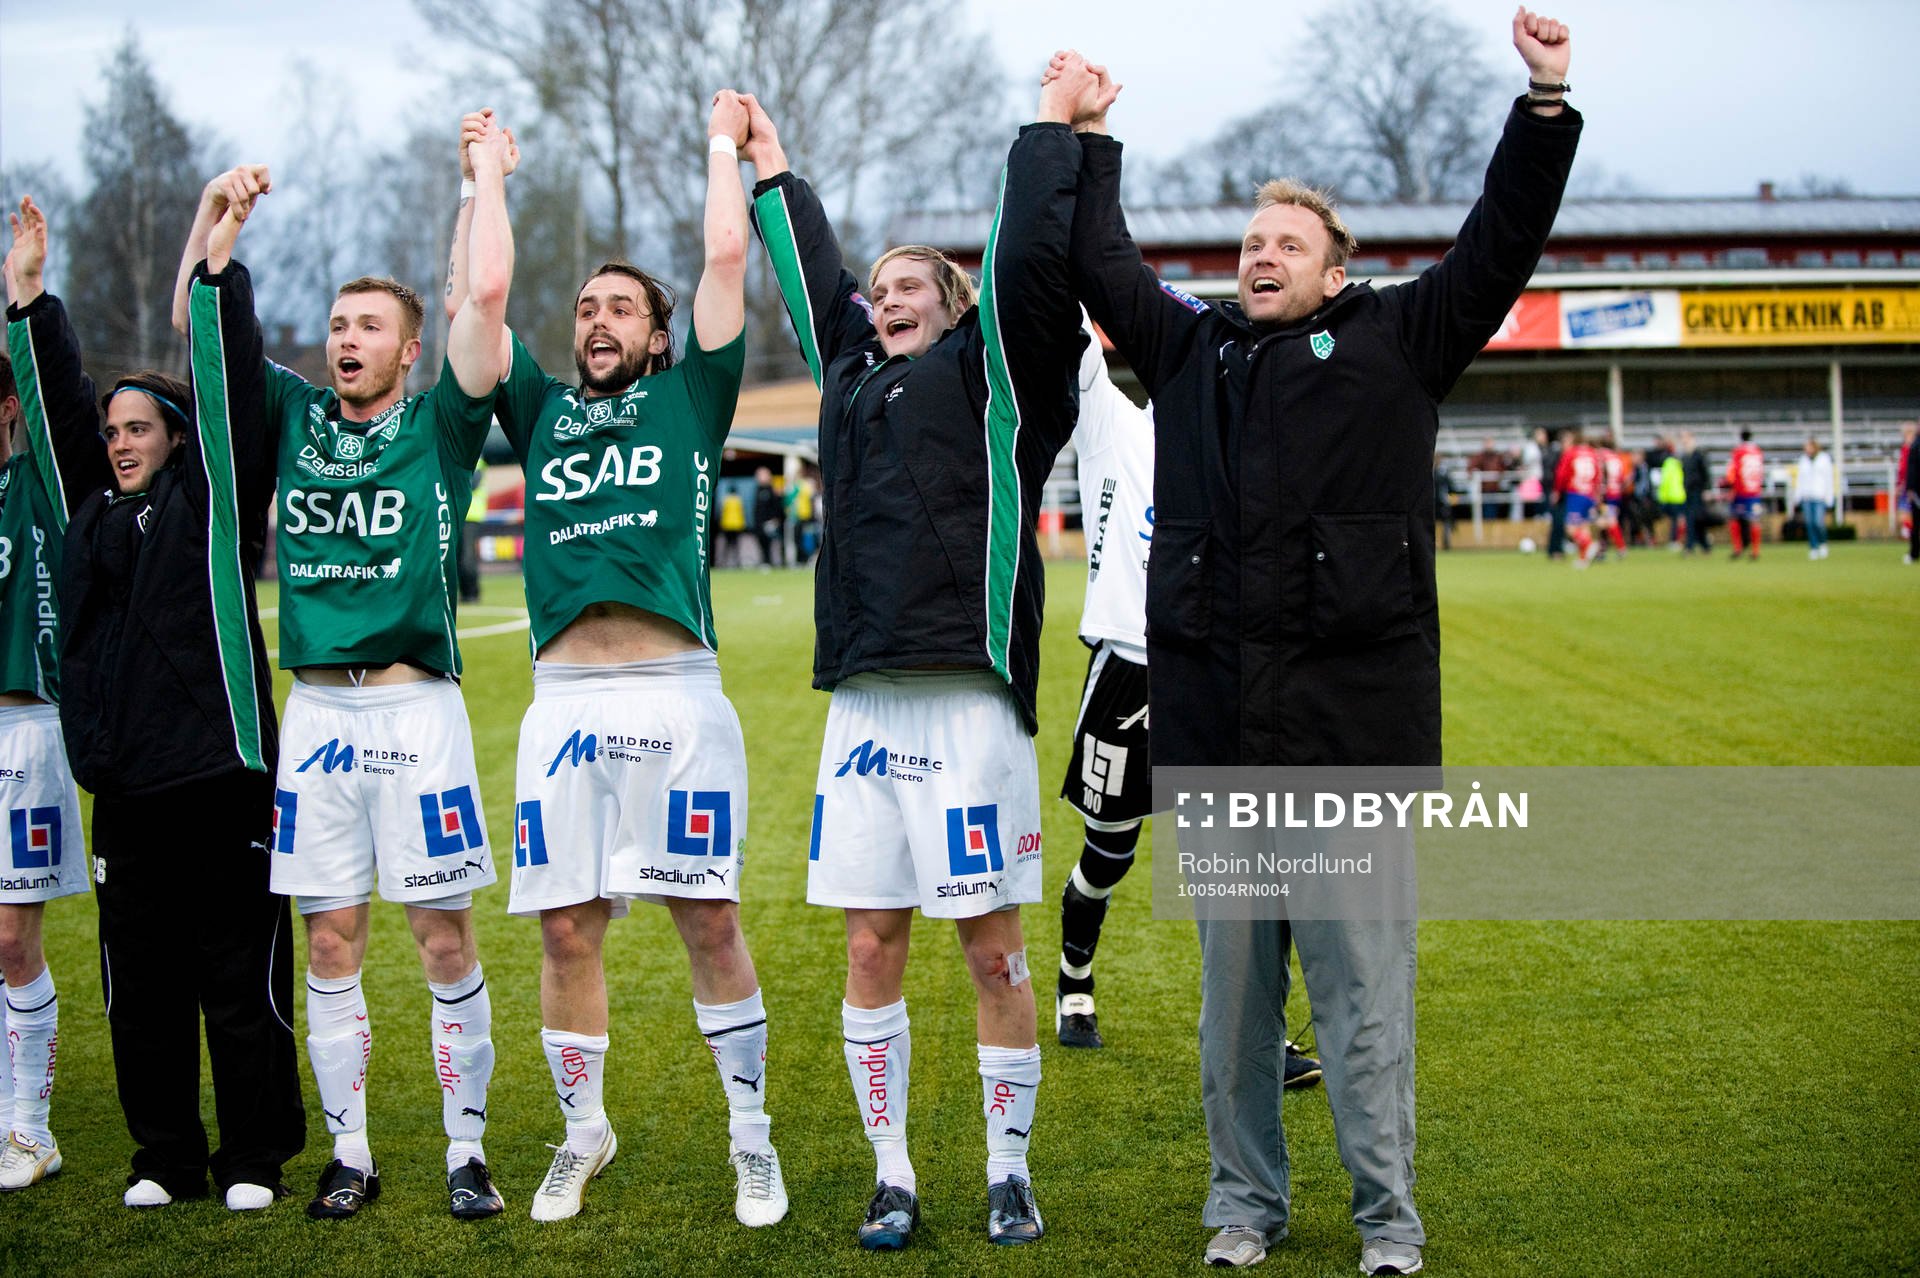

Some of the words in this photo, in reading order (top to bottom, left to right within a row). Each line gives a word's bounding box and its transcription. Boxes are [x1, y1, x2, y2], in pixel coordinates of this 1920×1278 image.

[1853, 300, 1885, 327] AB
[536, 445, 663, 501] SSAB
[285, 489, 406, 537] SSAB
[549, 513, 635, 545] DALATRAFIK
[289, 563, 379, 579] DALATRAFIK
[607, 735, 672, 750] MIDROC
[363, 749, 418, 763] MIDROC
[889, 752, 943, 770] MIDRC
[363, 764, 395, 775] Electro
[890, 768, 923, 783] Electro
[1083, 786, 1102, 814] 100
[0, 876, 49, 890] tadium
[404, 867, 468, 888] stadium
[639, 866, 705, 884] stadium
[936, 881, 988, 898] stdium
[859, 1042, 890, 1127] Scandic
